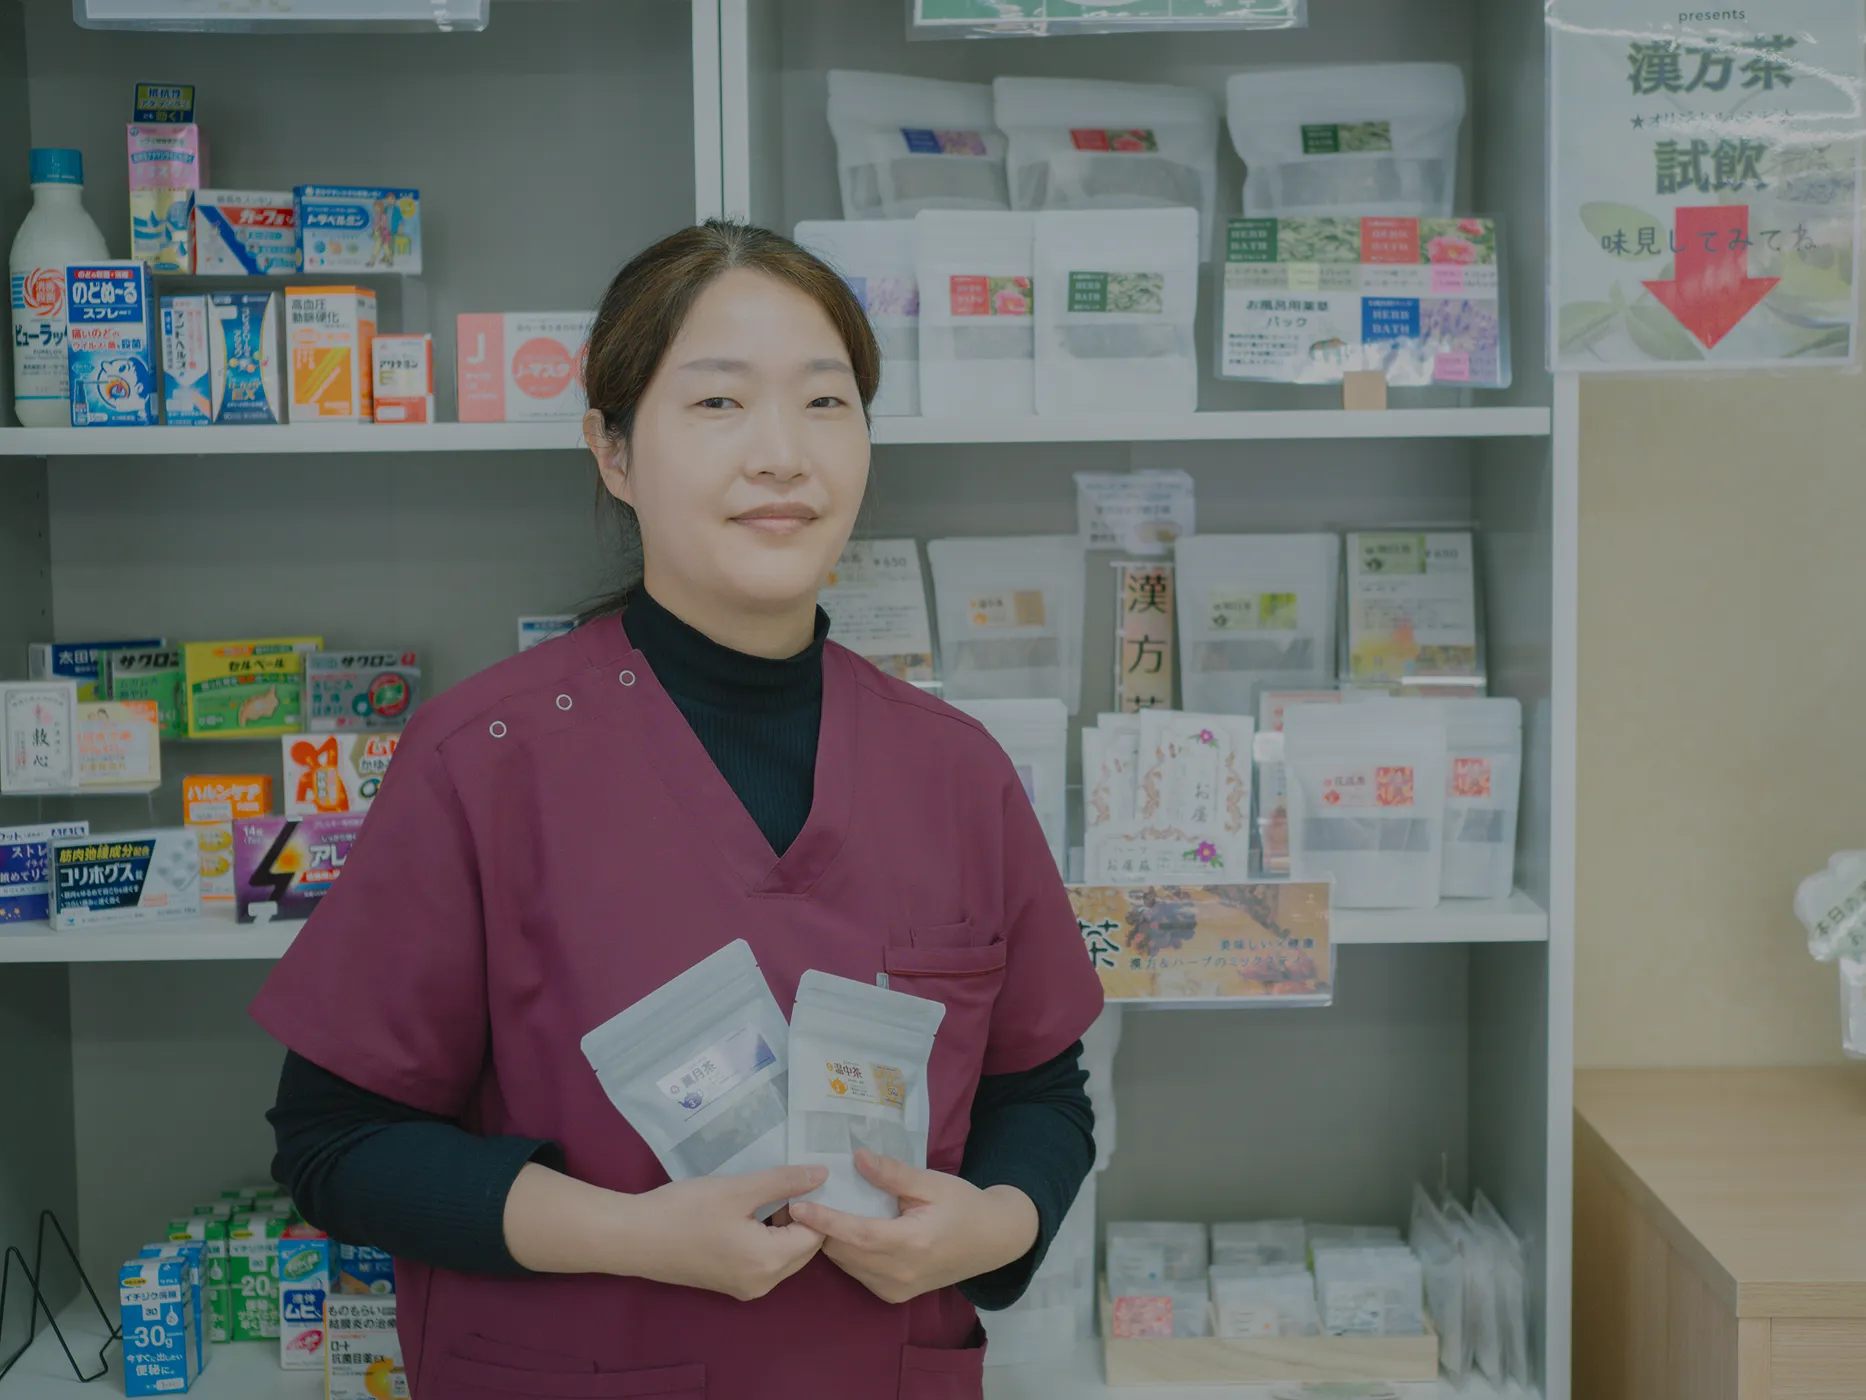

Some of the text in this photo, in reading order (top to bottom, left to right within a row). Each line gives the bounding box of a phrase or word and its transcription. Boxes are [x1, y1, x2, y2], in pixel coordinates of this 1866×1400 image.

[1678, 9, 1745, 23] presents
[1627, 34, 1799, 96] 漢方茶
[1655, 139, 1769, 196] 試飲
[1601, 223, 1817, 258] 味見してみてね
[292, 299, 325, 310] 高血圧
[83, 308, 128, 319] スプレー
[1372, 310, 1410, 320] HERB
[1268, 316, 1307, 328] パック
[1372, 324, 1410, 334] BATH
[15, 324, 67, 346] ピューラッ
[467, 332, 485, 364] J
[228, 658, 285, 673] セルベール
[33, 728, 51, 768] 救心
[188, 784, 260, 800] ハルンケア
[134, 1325, 173, 1349] 30g
